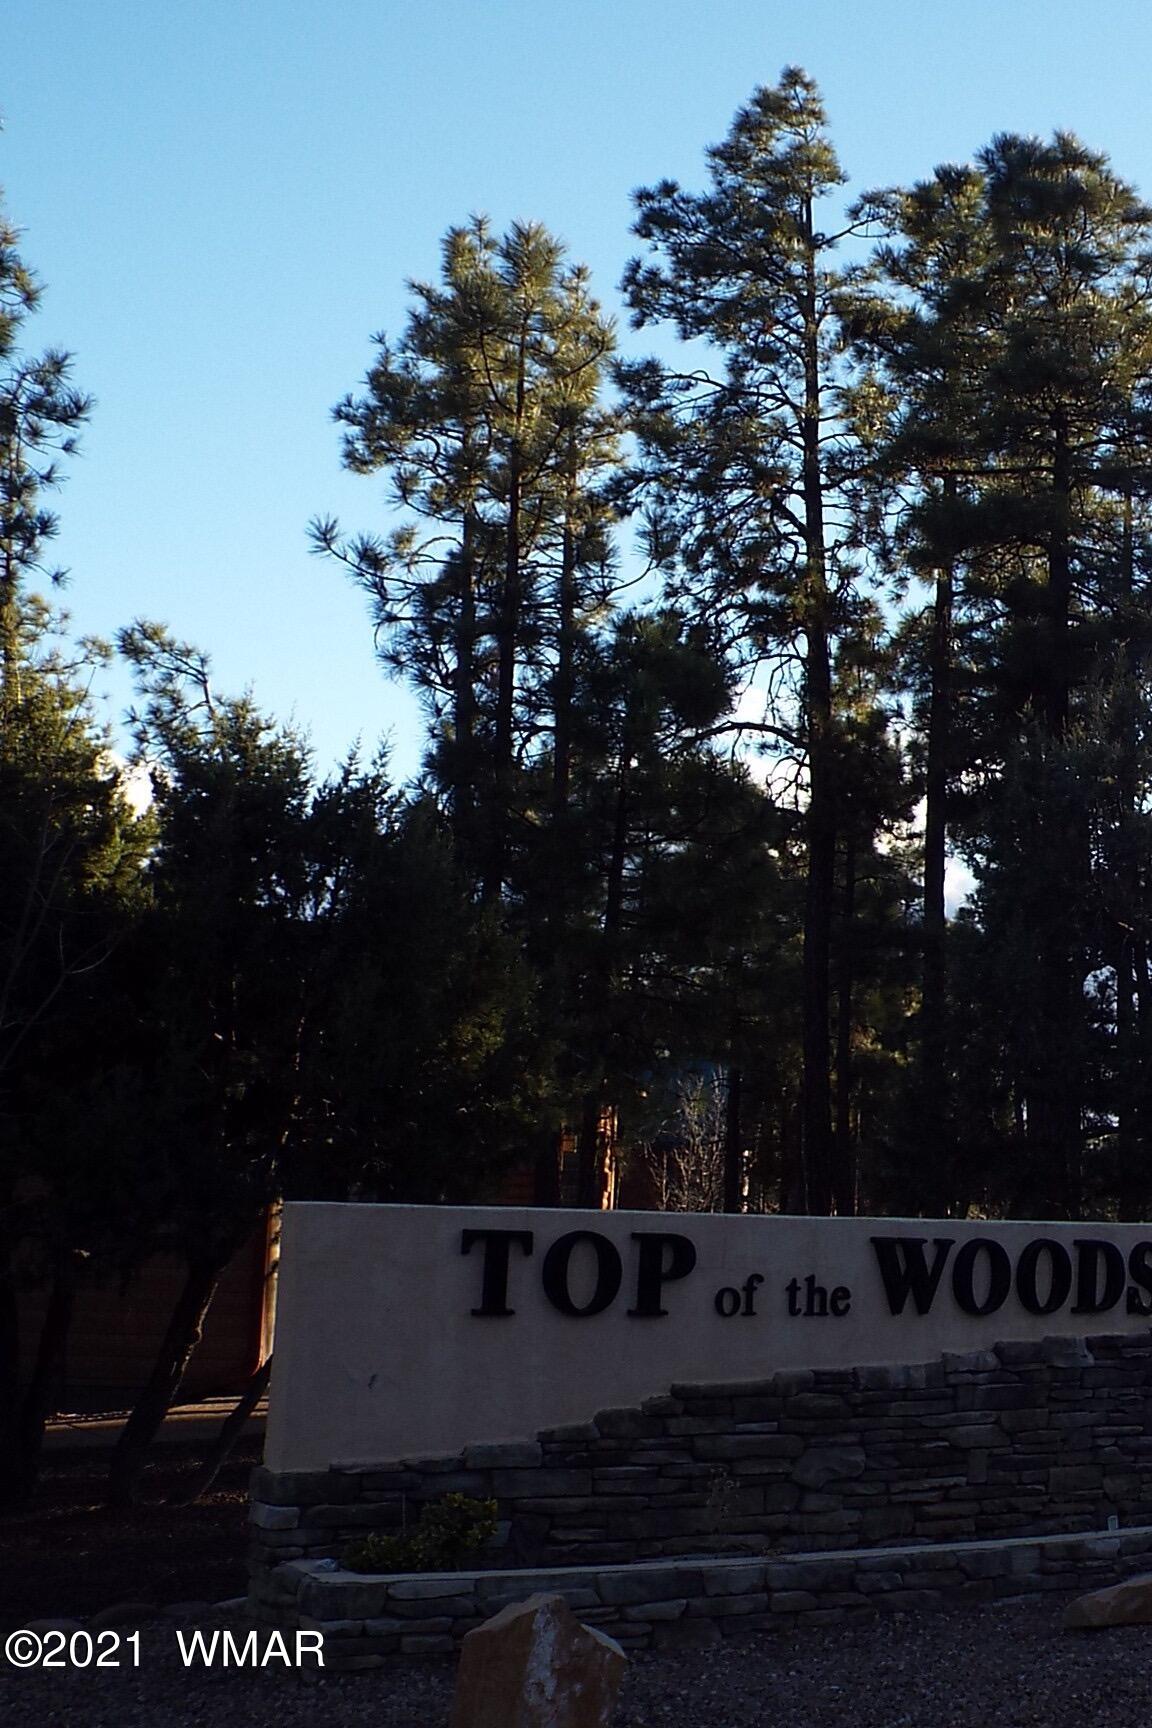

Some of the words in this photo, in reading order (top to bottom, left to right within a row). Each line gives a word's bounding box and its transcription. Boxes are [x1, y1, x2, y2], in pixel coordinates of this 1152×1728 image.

[461, 1229, 697, 1317] TOP
[715, 1274, 764, 1317] of
[785, 1275, 852, 1316] the
